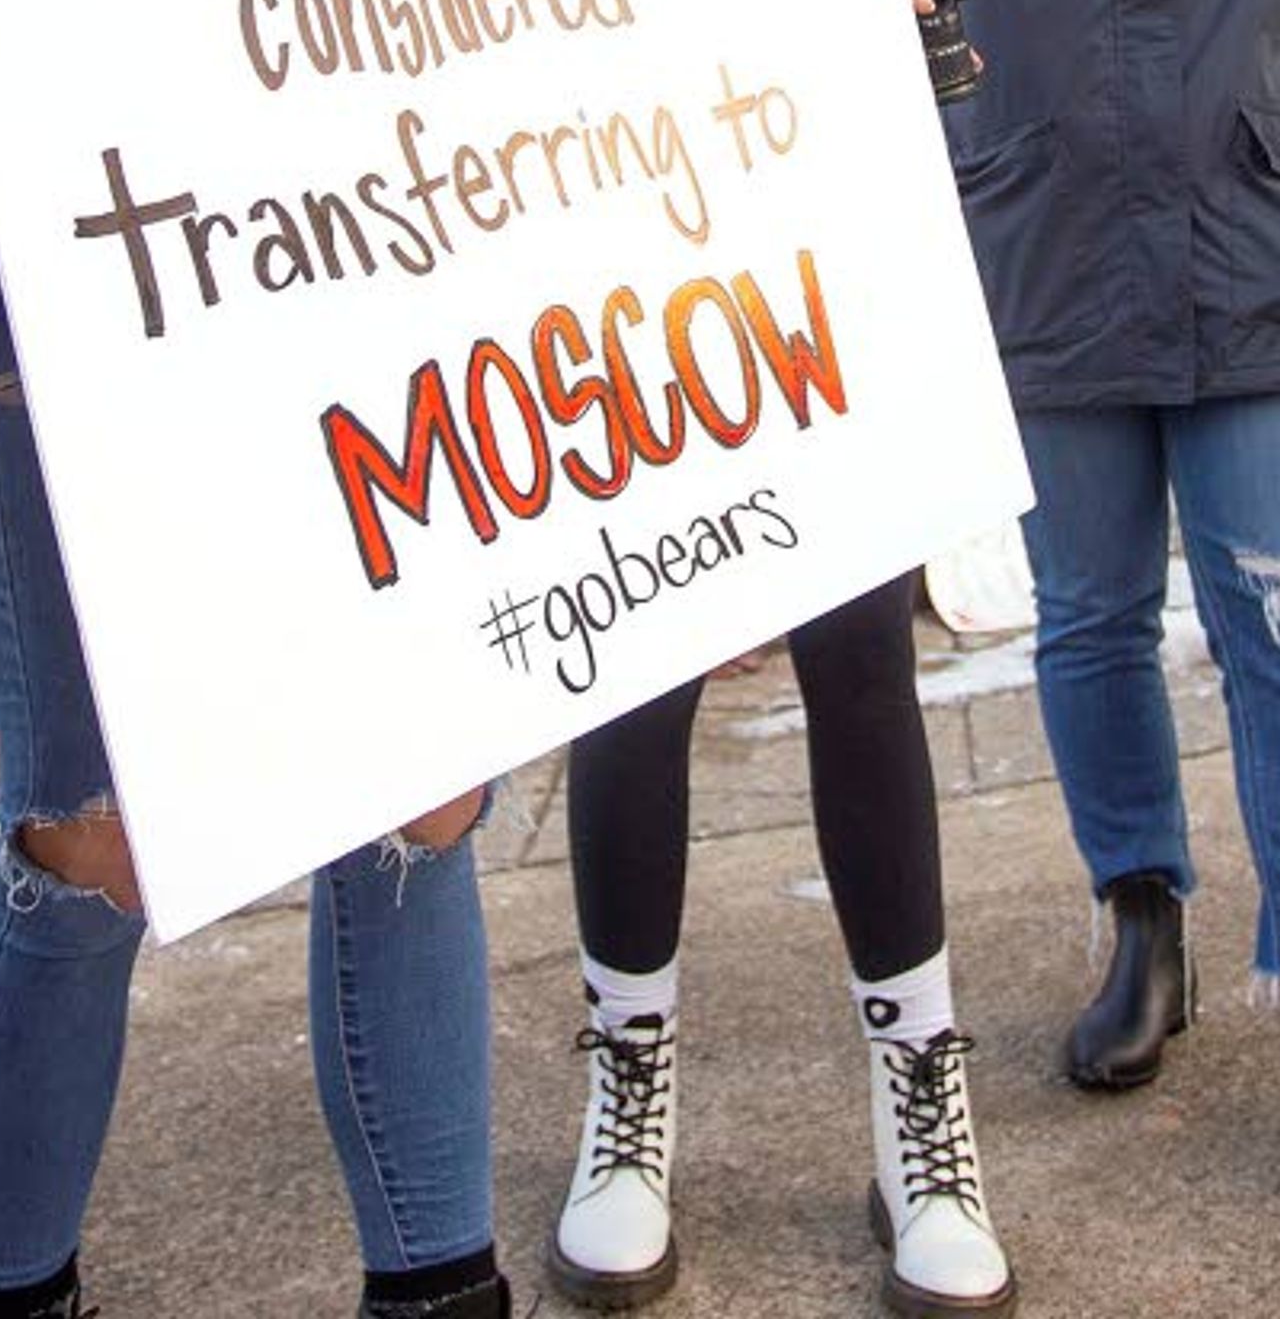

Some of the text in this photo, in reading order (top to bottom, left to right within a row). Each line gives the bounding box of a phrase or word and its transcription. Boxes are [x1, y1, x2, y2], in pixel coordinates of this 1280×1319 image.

[75, 64, 797, 340] transferring to
[318, 249, 849, 593] MOSCOW
[479, 489, 799, 694] #gobears
